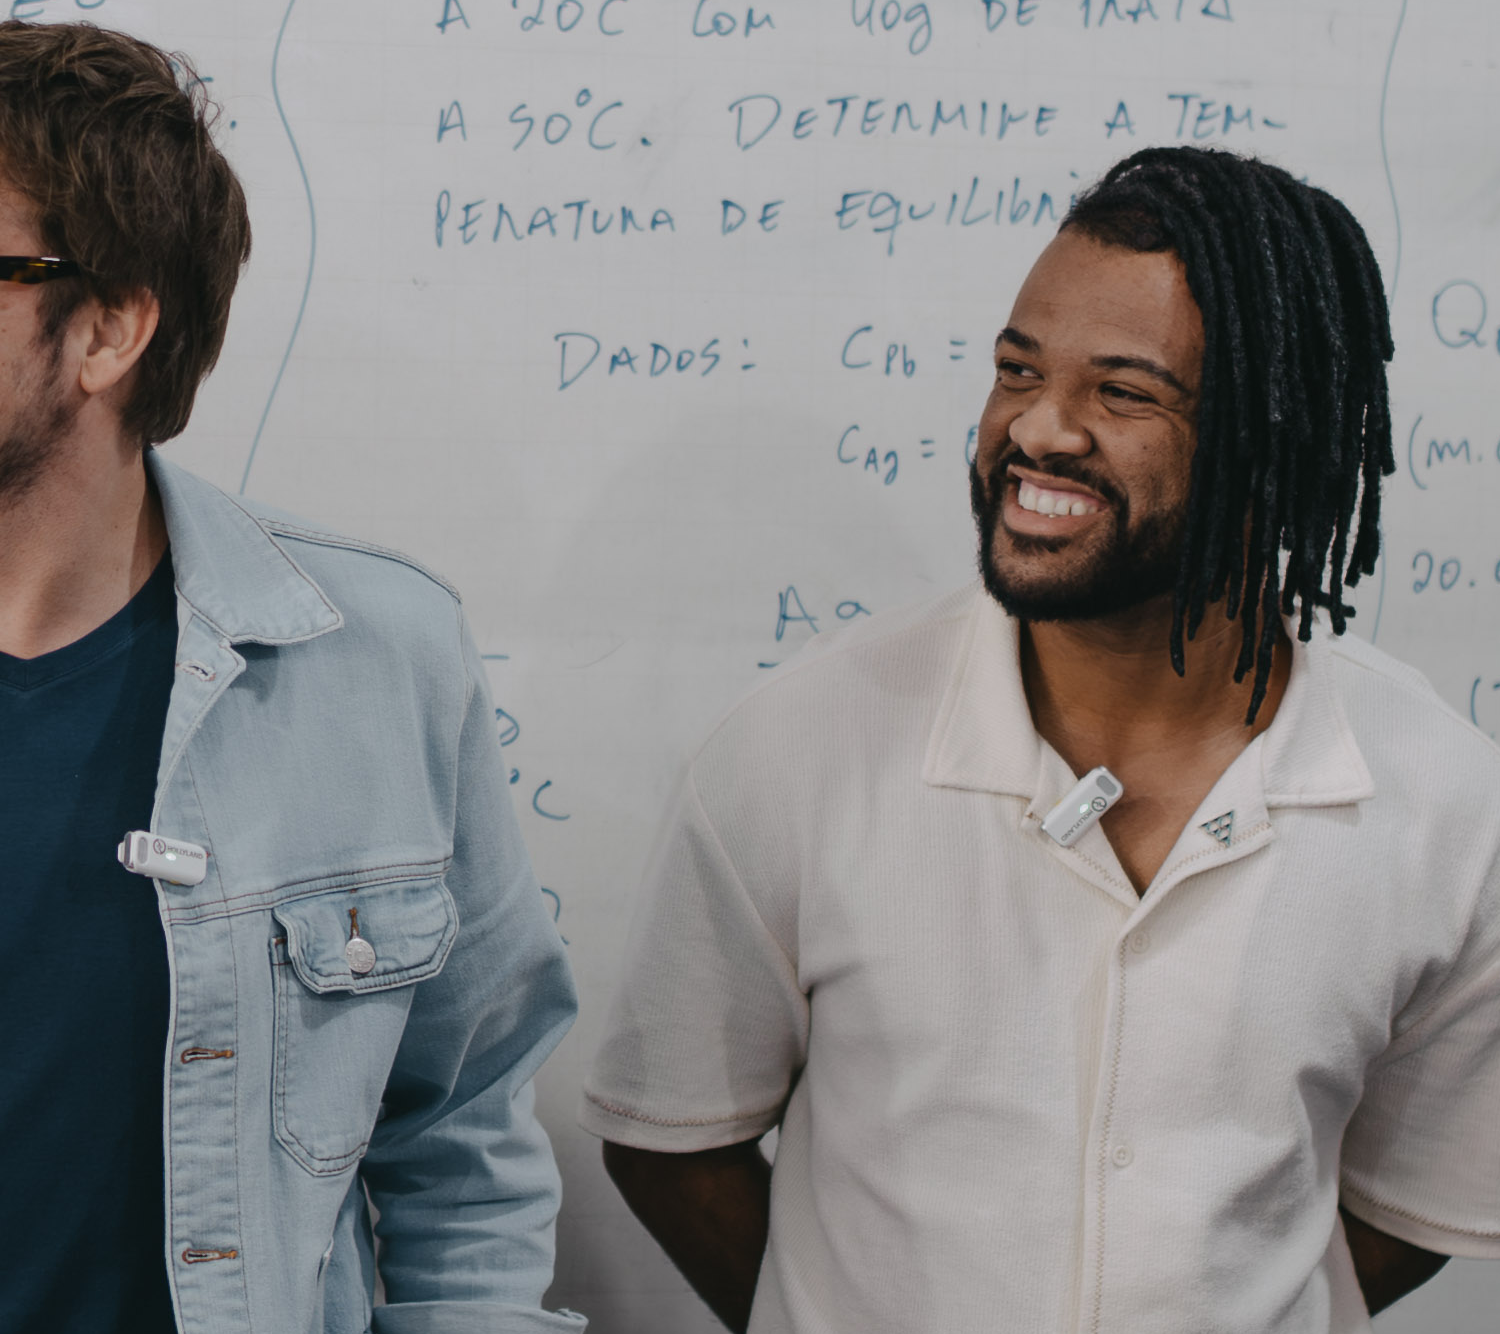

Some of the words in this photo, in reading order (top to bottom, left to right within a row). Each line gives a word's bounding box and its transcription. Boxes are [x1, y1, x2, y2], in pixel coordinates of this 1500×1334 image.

[437, 100, 467, 143] A
[728, 94, 1059, 151] DETERMINE
[1105, 100, 1136, 139] A
[721, 198, 786, 237] DE
